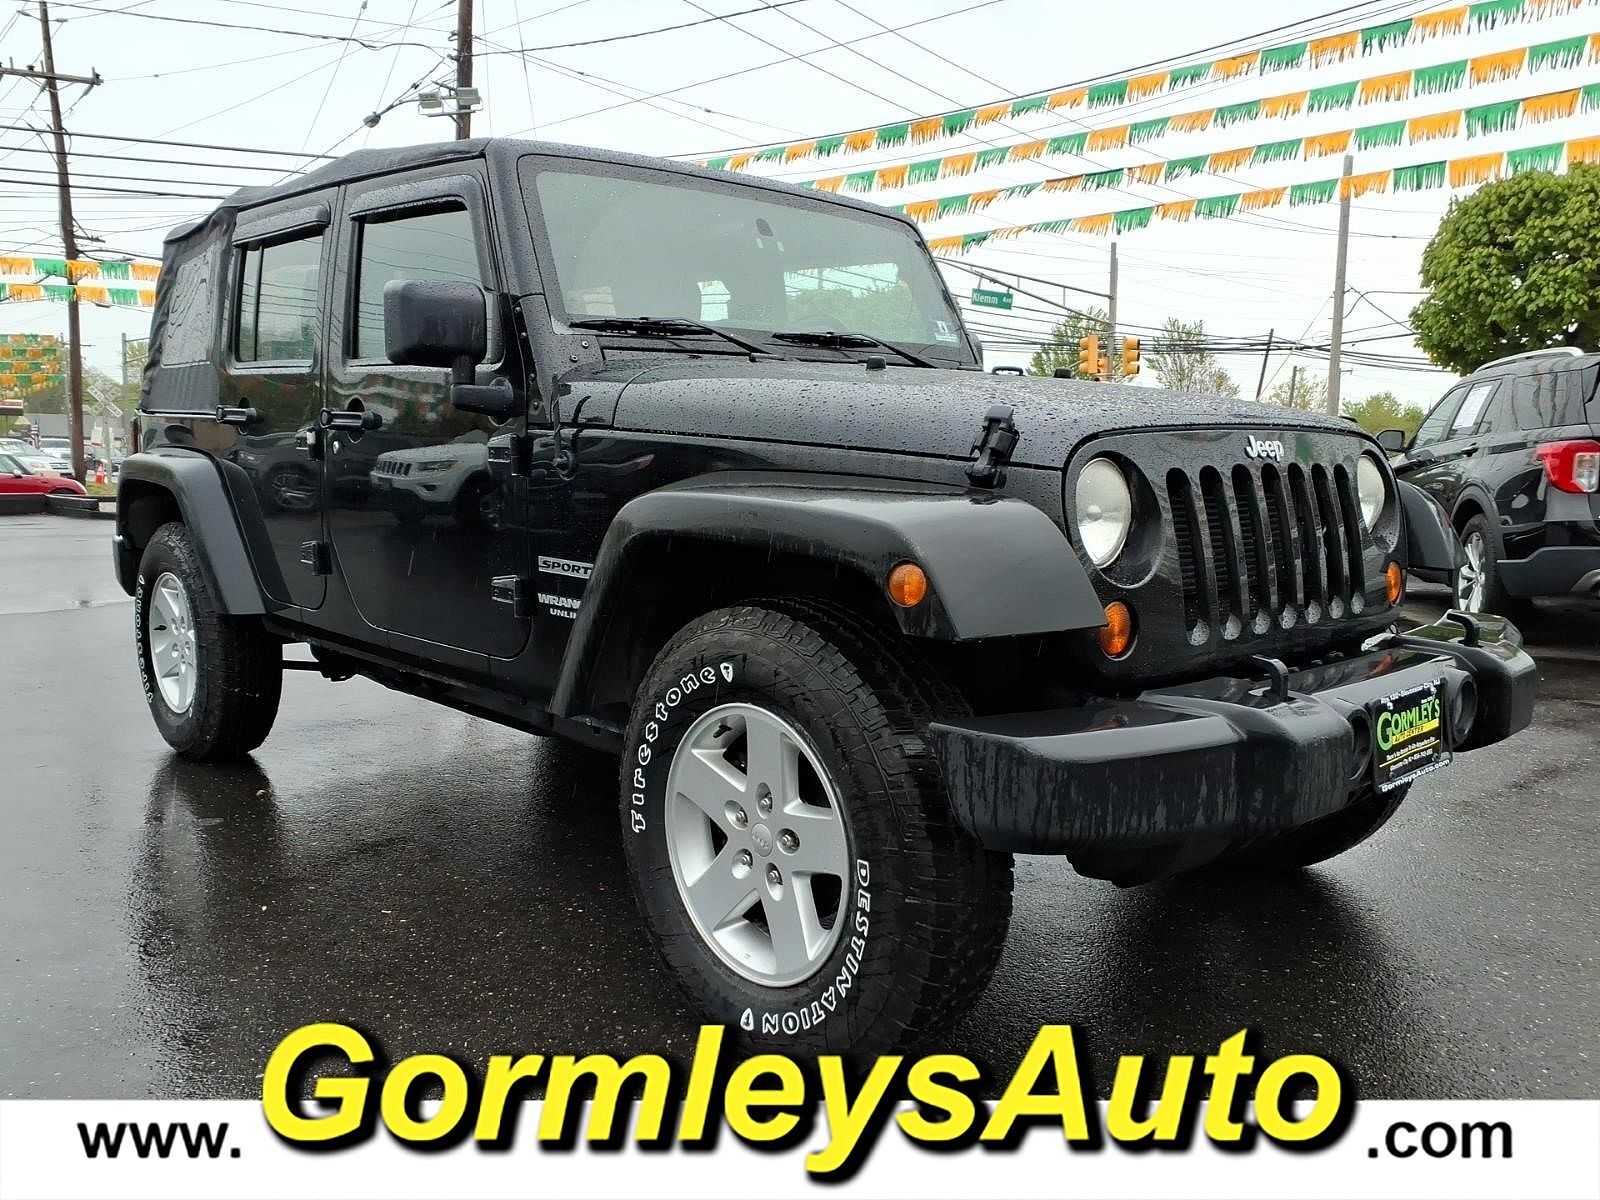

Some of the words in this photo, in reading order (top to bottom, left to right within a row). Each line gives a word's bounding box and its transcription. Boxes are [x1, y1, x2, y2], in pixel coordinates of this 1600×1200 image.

[972, 292, 998, 305] Klemm
[1246, 434, 1285, 462] Jeep
[539, 560, 592, 575] SPORT
[631, 667, 716, 833] Firestone
[762, 859, 871, 1035] DESTINATION
